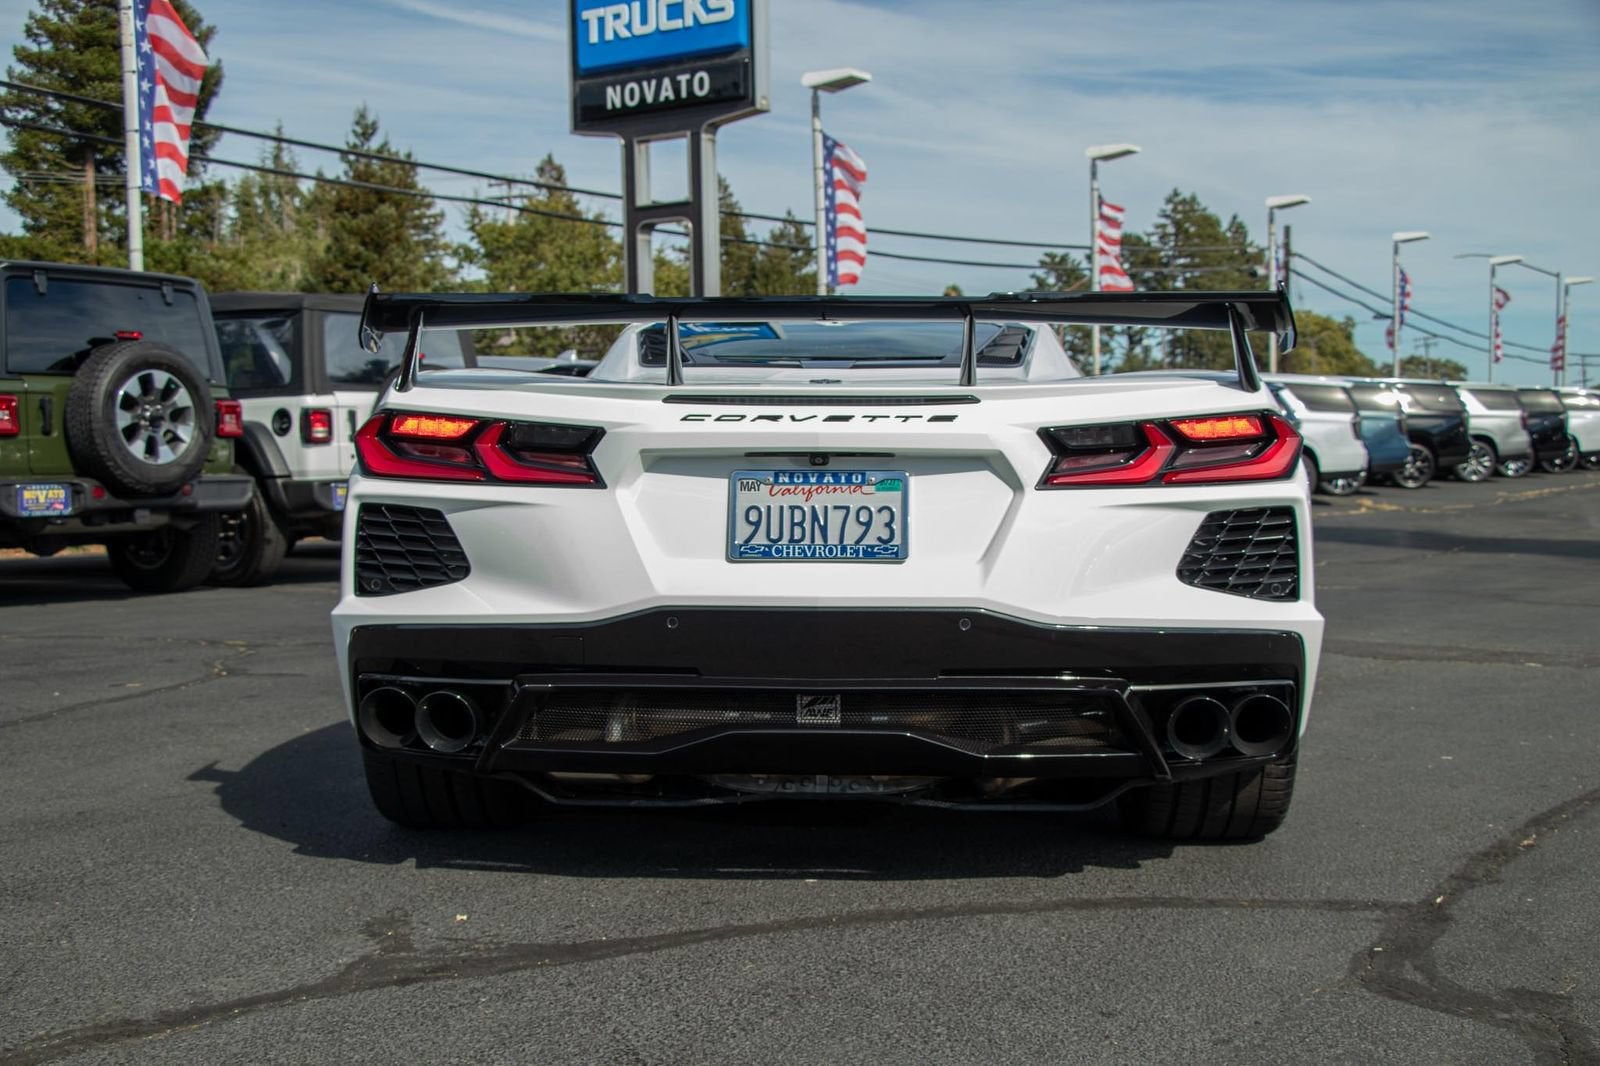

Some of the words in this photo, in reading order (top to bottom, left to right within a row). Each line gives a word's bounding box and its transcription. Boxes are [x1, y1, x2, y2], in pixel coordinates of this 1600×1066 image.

[581, 0, 735, 44] TRUCKS
[605, 71, 711, 111] NOVATO
[680, 414, 959, 422] CORVETTE
[777, 472, 863, 484] NOVATO
[740, 480, 761, 492] MAY
[768, 484, 876, 502] California
[744, 505, 896, 544] 9UBN793
[771, 545, 867, 558] CHEVROLET
